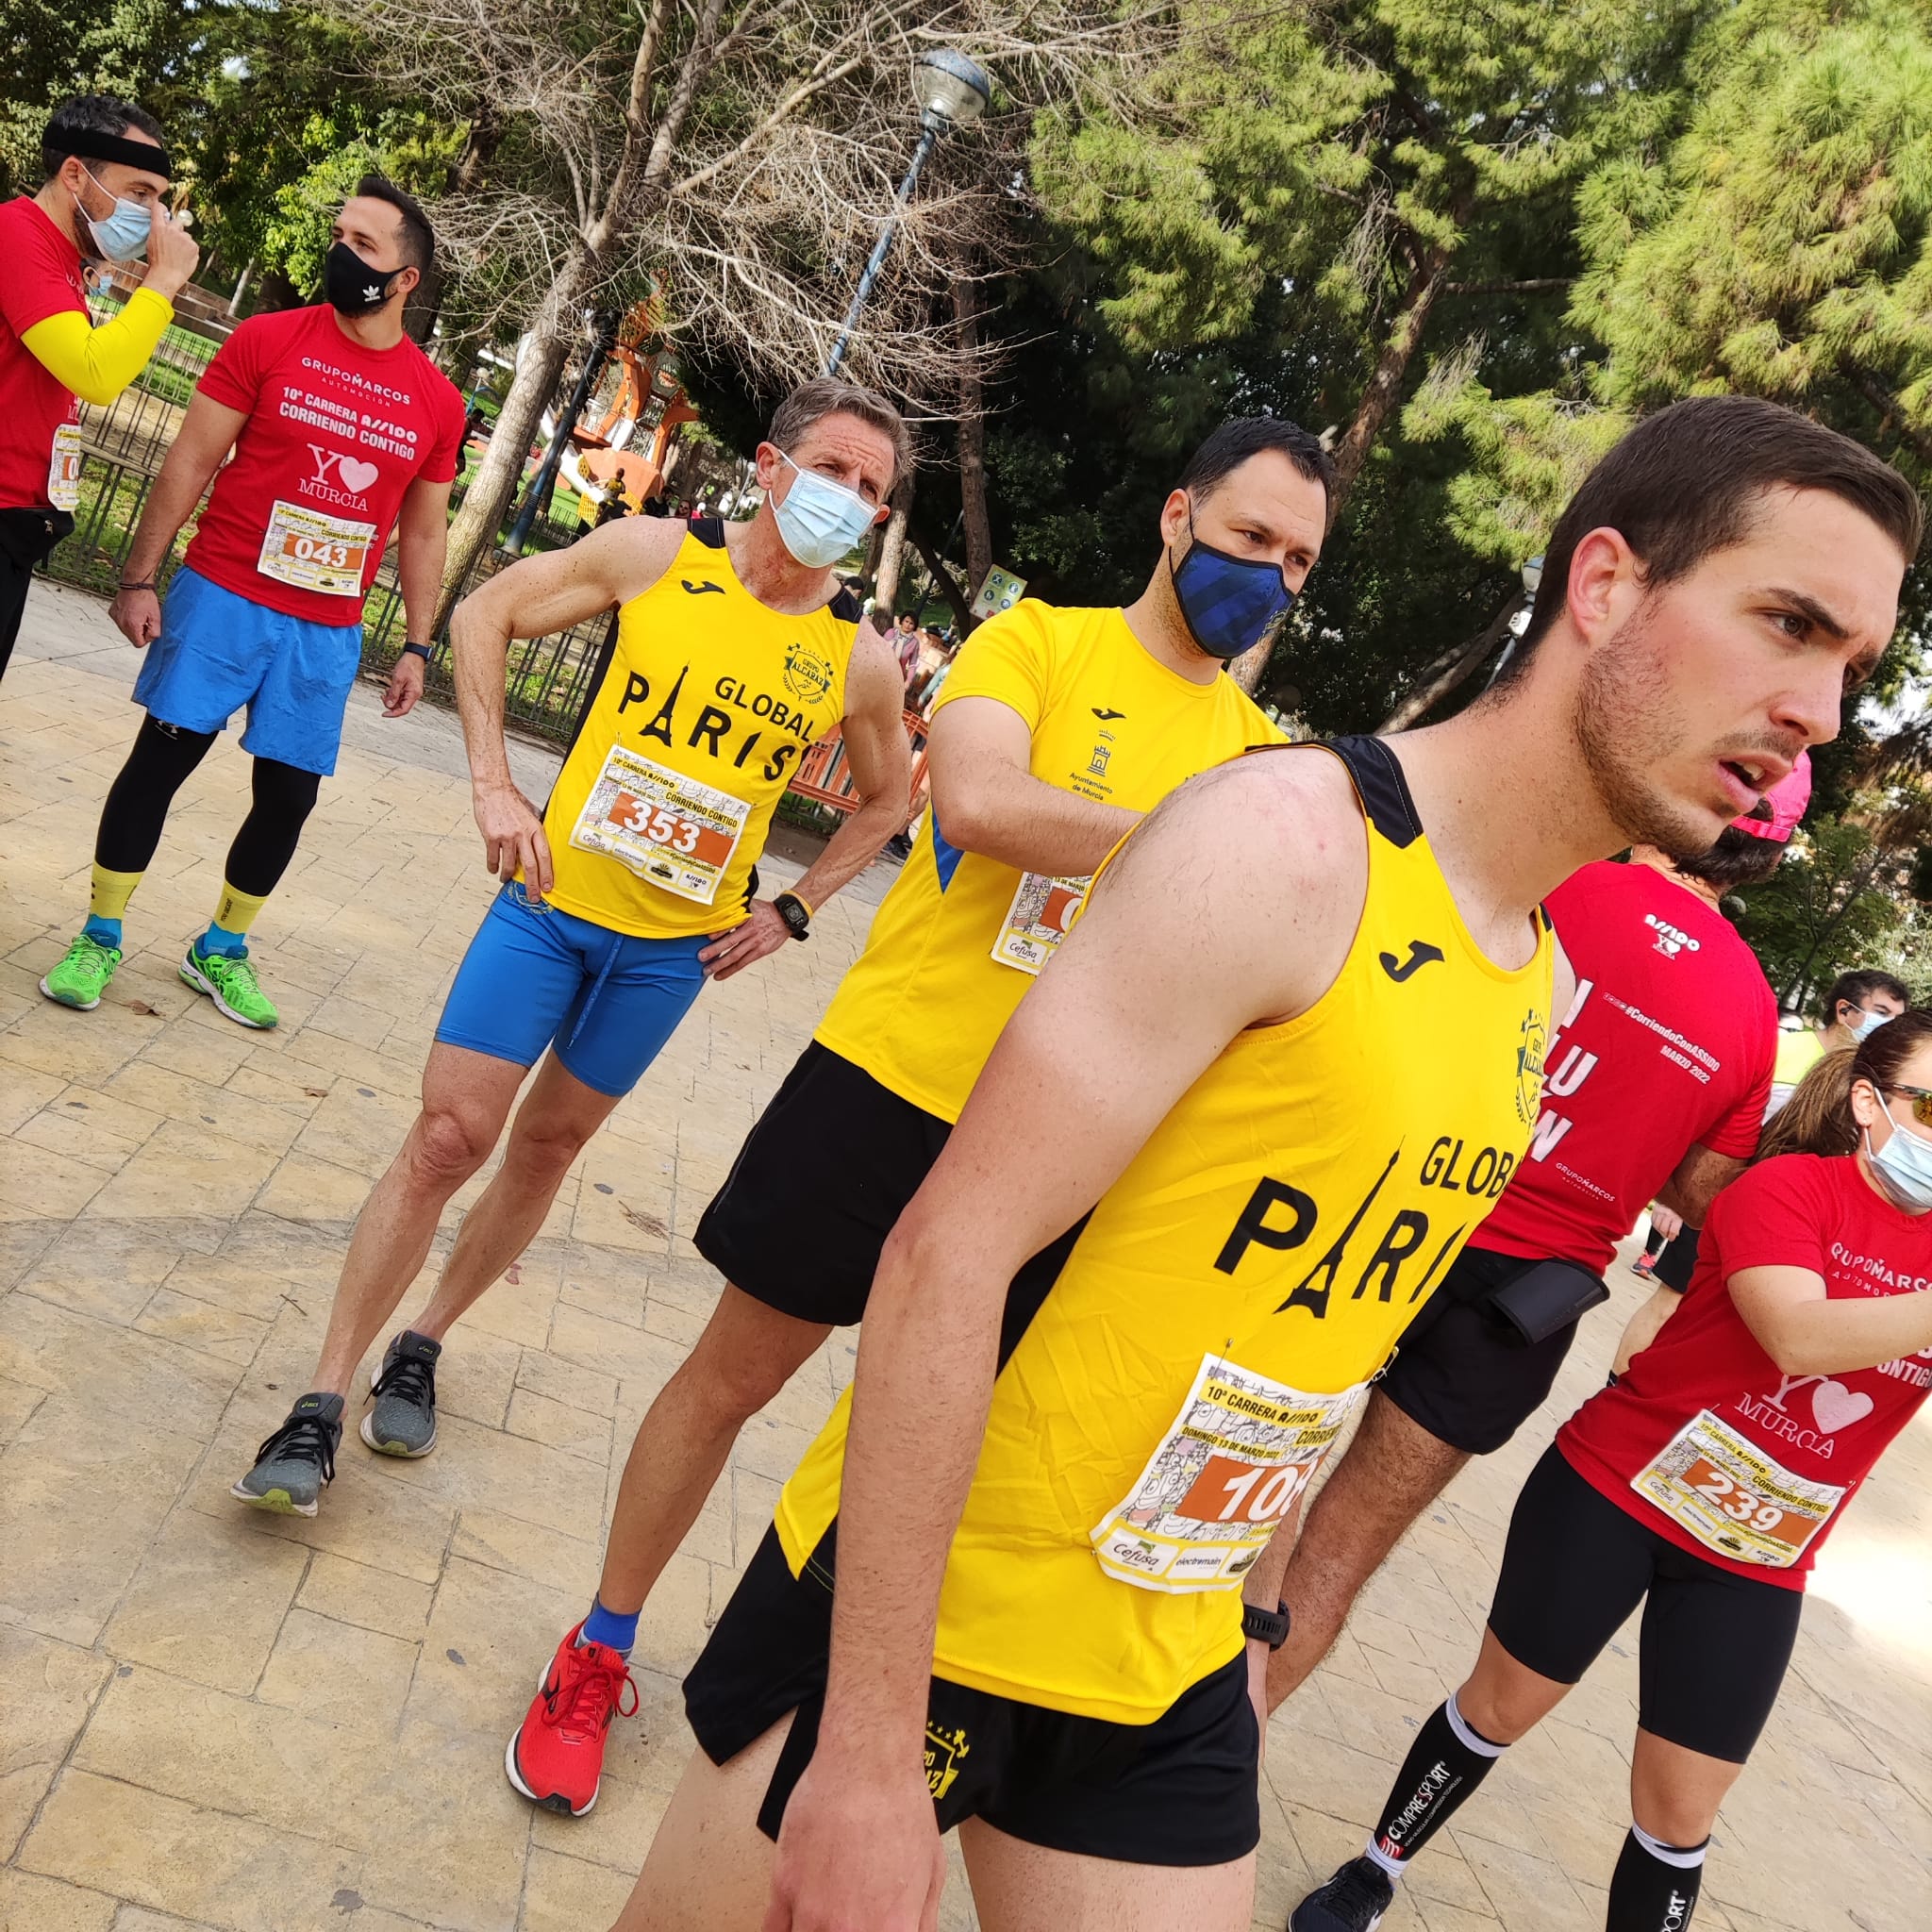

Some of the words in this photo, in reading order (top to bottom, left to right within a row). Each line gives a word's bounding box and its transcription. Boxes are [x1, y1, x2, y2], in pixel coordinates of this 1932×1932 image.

[305, 393, 358, 423] CARRERA
[279, 402, 357, 440] CORRIENDO
[359, 430, 415, 461] CONTIGO
[307, 442, 345, 485] Y
[297, 477, 369, 512] MURCIA
[294, 538, 348, 568] 043
[617, 660, 796, 782] PARIS
[715, 676, 816, 743] GLOBAL
[623, 760, 647, 776] CARRERA
[1069, 773, 1113, 794] Ayuntamiento
[665, 791, 708, 816] CORRIENDO
[708, 809, 738, 828] CONTIGO
[1082, 787, 1104, 801] Murcia
[624, 801, 701, 853] 353
[1009, 942, 1038, 958] Cefusa
[1660, 1044, 1693, 1070] MARZO
[1689, 1065, 1711, 1085] 2022
[1420, 1136, 1516, 1199] GLOB
[1213, 1134, 1468, 1320] PARI
[1227, 1393, 1276, 1420] CARRERA
[1734, 1391, 1836, 1459] MURCIA
[1181, 1426, 1218, 1444] DOMINGO
[1219, 1438, 1227, 1448] 13
[1228, 1441, 1240, 1452] DE
[1240, 1444, 1263, 1457] MARZO
[1710, 1430, 1737, 1453] CARRERA
[1695, 1472, 1785, 1532] 239
[1752, 1474, 1797, 1504] CORRIENDO
[1796, 1497, 1830, 1514] CONTIGO
[1113, 1542, 1160, 1568] Cefusa
